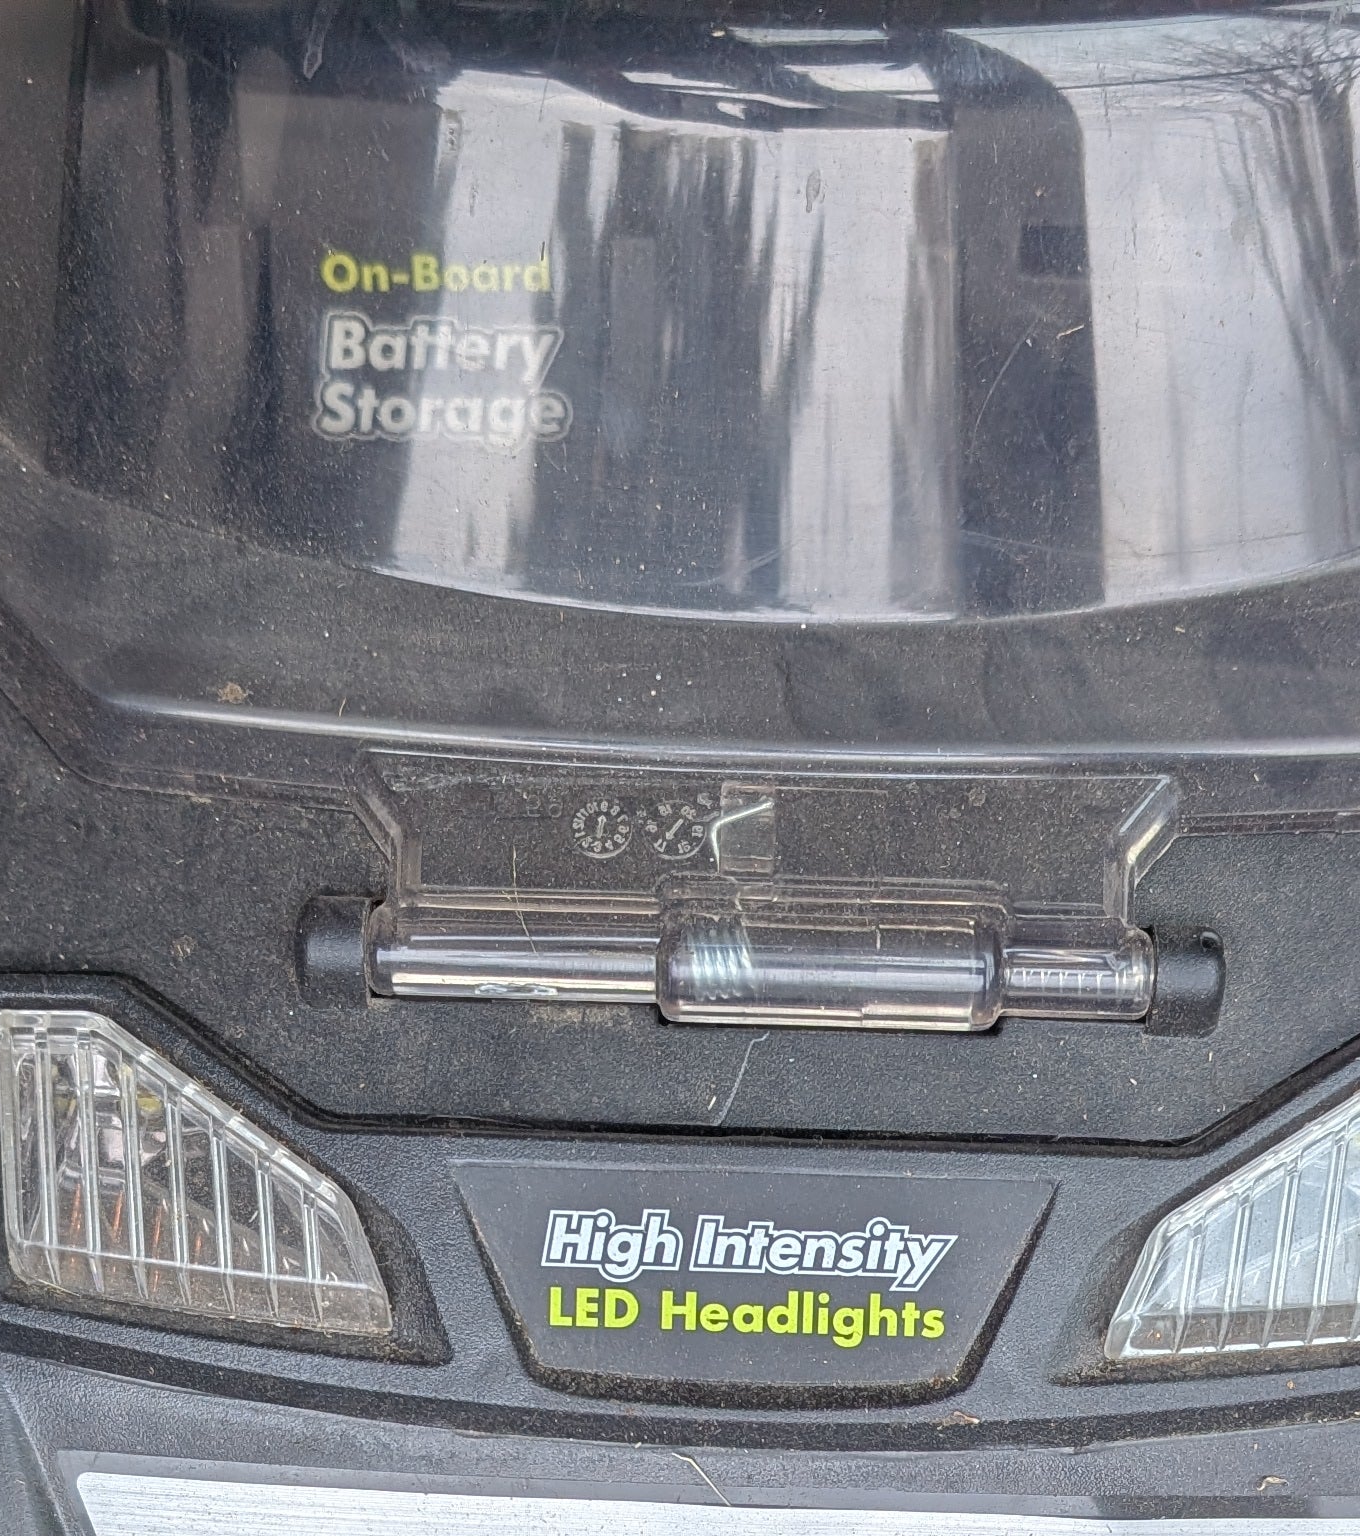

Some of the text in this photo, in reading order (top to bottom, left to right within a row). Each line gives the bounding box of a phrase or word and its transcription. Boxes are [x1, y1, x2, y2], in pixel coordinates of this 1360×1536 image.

[320, 252, 551, 292] On-Board
[327, 317, 559, 393] Battery
[318, 381, 569, 445] Storage
[544, 1209, 954, 1290] High Intensity
[548, 1286, 946, 1349] LED Headlights
